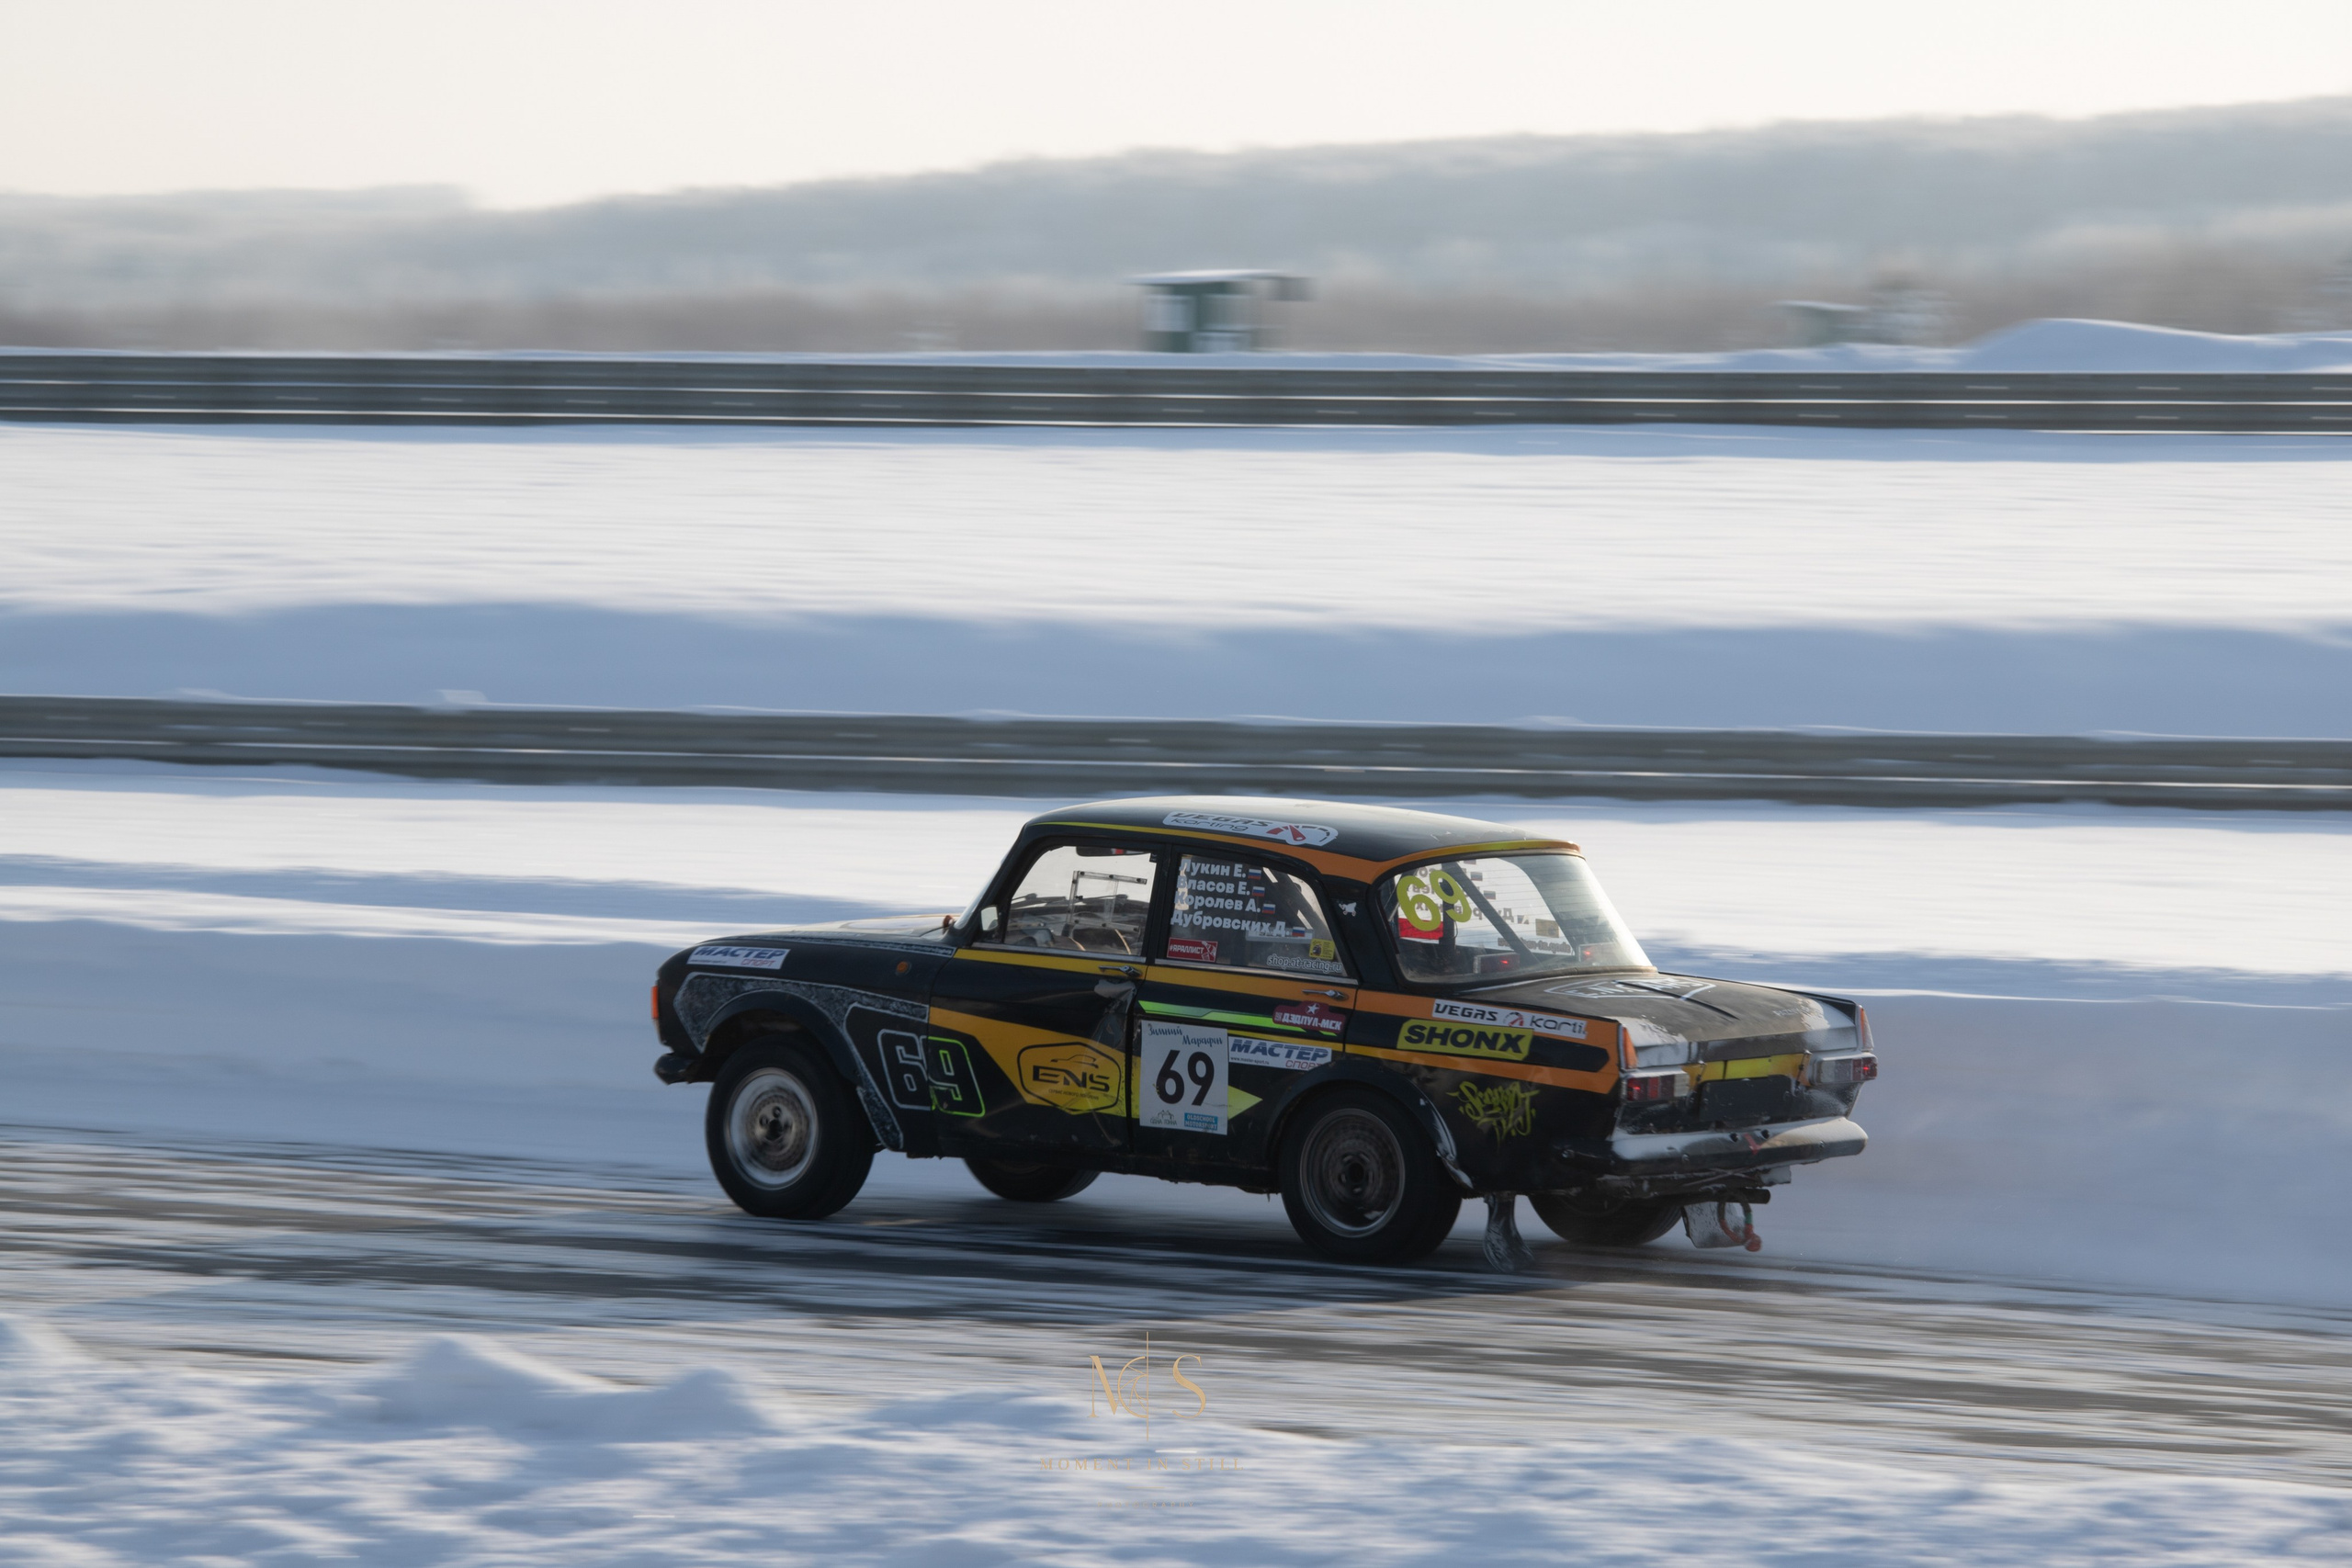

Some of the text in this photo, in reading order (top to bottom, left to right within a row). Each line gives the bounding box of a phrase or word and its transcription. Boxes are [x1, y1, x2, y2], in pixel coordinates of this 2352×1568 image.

[1170, 818, 1250, 832] karting
[1171, 812, 1274, 827] VEGAS
[1179, 858, 1247, 879] Лукин Е.
[1176, 875, 1250, 896] Власов Е.
[1174, 890, 1261, 913] Королев А.
[1396, 869, 1472, 931] 69
[1170, 910, 1290, 937] Дубровских Д.
[694, 946, 786, 960] МАСТЕР
[741, 958, 776, 967] СПОРТ
[1266, 953, 1343, 974] shop.at-racing.ru
[1434, 1003, 1498, 1021] VEGAS
[1148, 1023, 1183, 1036] Зимний
[1404, 1024, 1526, 1054] SHONX
[1182, 1035, 1223, 1047] Марафон
[1230, 1039, 1329, 1061] МАСТЕР
[876, 1028, 986, 1118] 69
[1032, 1065, 1110, 1093] ENS
[1156, 1049, 1215, 1106] 69
[1186, 1114, 1216, 1123] OLDSCHOOL
